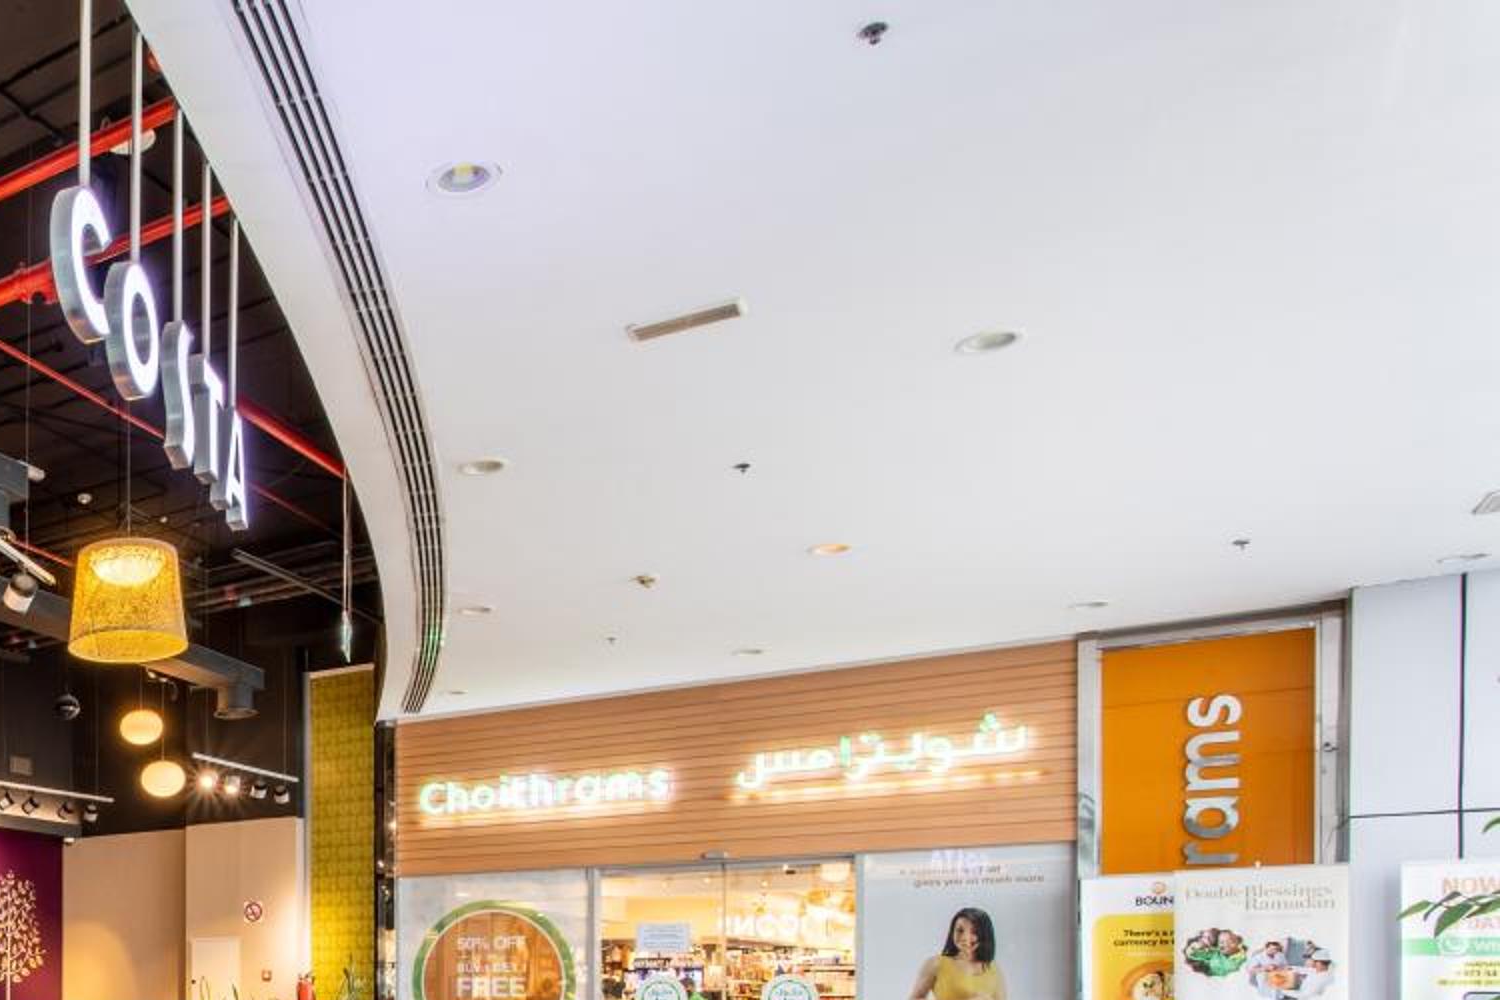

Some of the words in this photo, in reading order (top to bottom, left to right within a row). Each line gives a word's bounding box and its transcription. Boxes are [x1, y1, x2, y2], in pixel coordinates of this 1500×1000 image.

[51, 185, 248, 531] COSTA
[418, 768, 671, 814] Choithrams
[1183, 694, 1242, 864] rams
[1245, 897, 1336, 911] Ramadan
[457, 976, 526, 998] FREE
